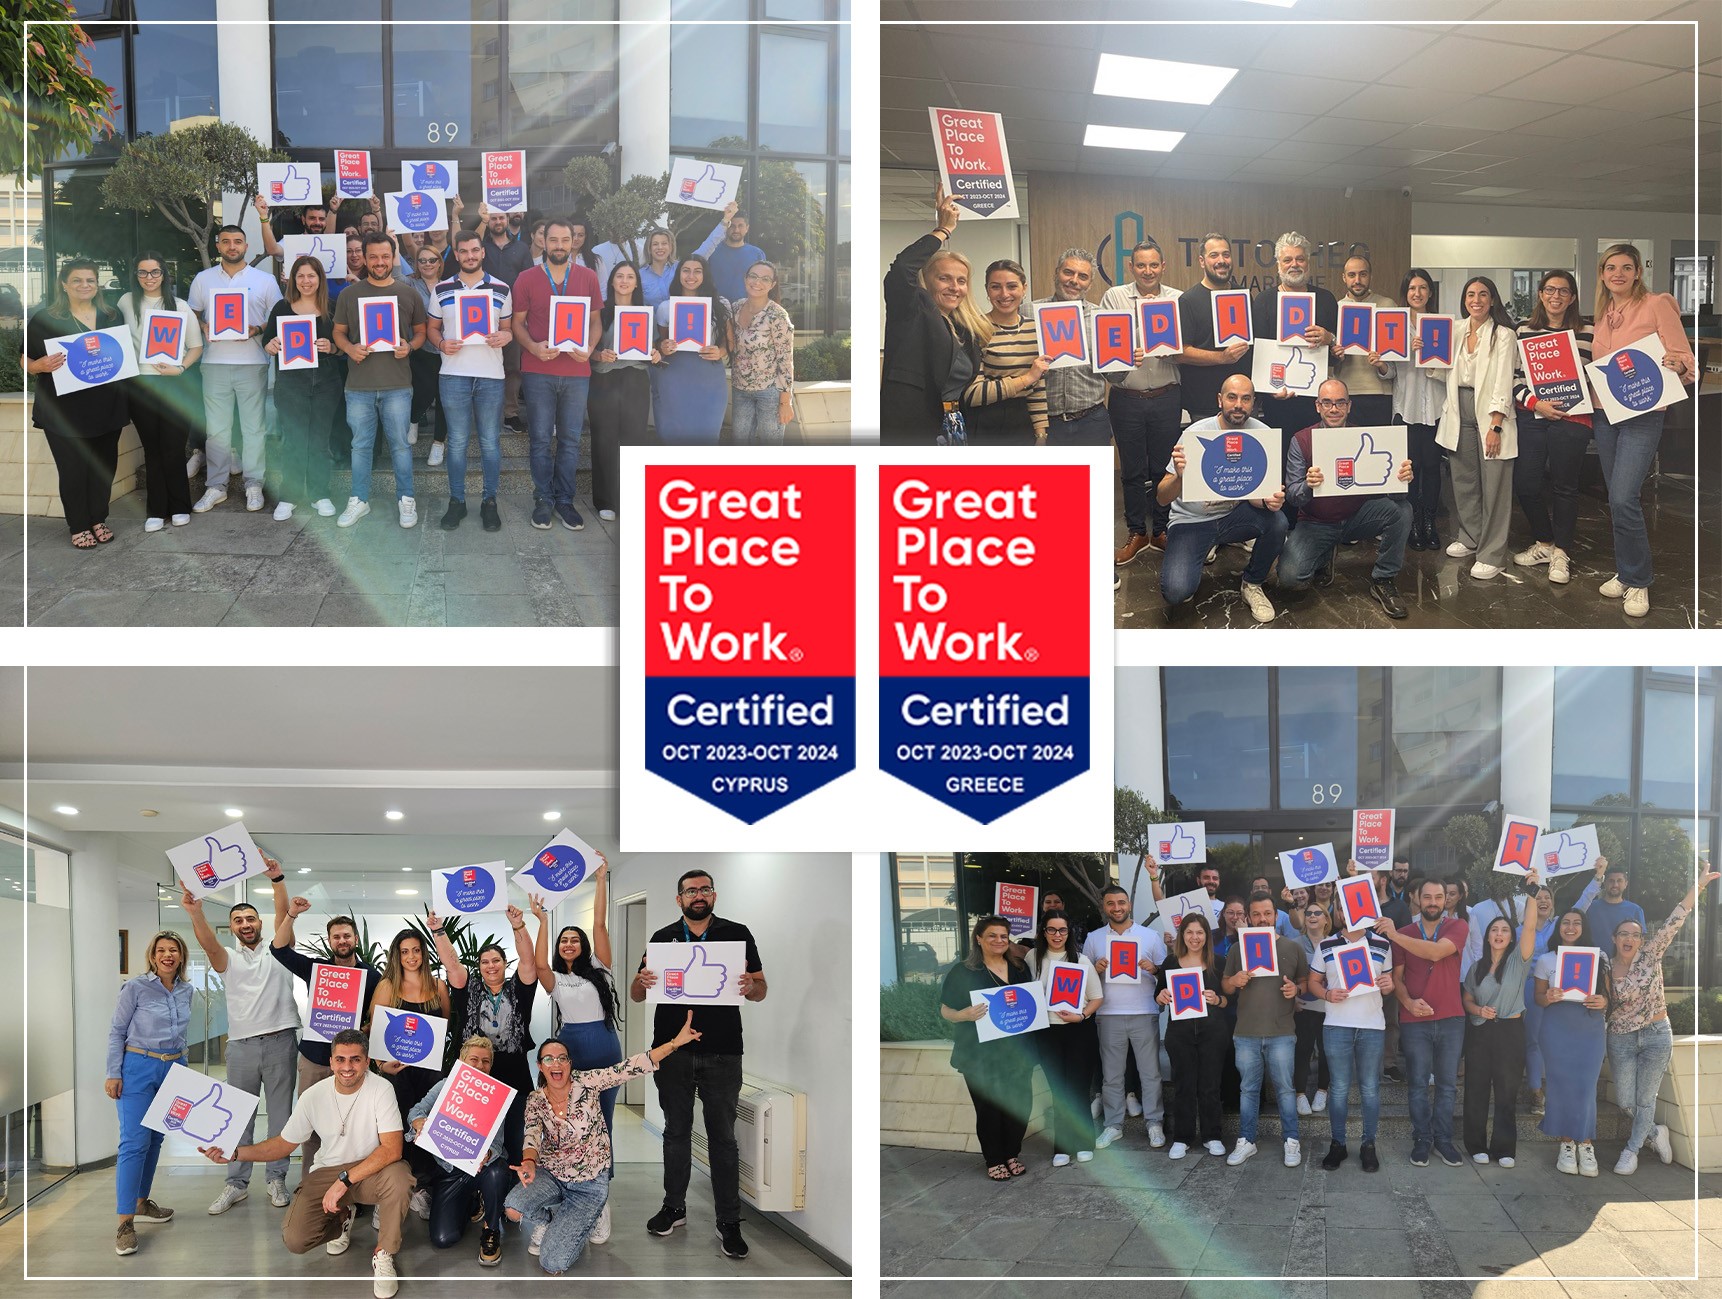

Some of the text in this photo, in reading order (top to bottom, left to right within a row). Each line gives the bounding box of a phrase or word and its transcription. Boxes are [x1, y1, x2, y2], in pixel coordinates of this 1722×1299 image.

[942, 114, 983, 129] Great
[428, 122, 458, 143] 89
[945, 129, 984, 142] Place
[946, 143, 963, 155] To
[489, 162, 512, 170] Place
[956, 179, 1003, 189] Certified
[224, 303, 235, 319] E
[468, 306, 483, 323] D
[1229, 305, 1237, 324] I
[1289, 307, 1305, 325] D
[376, 313, 383, 331] I
[566, 313, 573, 330] I
[687, 313, 694, 330] !
[1151, 313, 1170, 334] D
[1352, 317, 1360, 335] I
[153, 326, 178, 344] W
[627, 322, 641, 339] T
[1046, 319, 1076, 342] W
[1108, 327, 1121, 347] E
[1384, 322, 1398, 340] T
[1432, 328, 1439, 348] !
[290, 331, 306, 349] D
[1526, 338, 1558, 351] Great
[1529, 350, 1560, 361] Place
[1531, 362, 1543, 371] To
[1539, 383, 1577, 395] Certified
[1219, 476, 1236, 485] great
[1236, 475, 1253, 483] place
[1312, 784, 1342, 804] 89
[1515, 833, 1528, 852] T
[1002, 886, 1026, 894] Great
[1002, 892, 1025, 900] Place
[1355, 891, 1364, 909] I
[1119, 950, 1129, 966] E
[1255, 943, 1262, 958] I
[320, 968, 350, 979] Great
[1349, 959, 1363, 977] D
[1573, 962, 1581, 980] !
[318, 987, 329, 996] To
[319, 978, 348, 989] Place
[1056, 977, 1079, 993] W
[1180, 983, 1194, 1001] D
[316, 1012, 351, 1023] Certified
[461, 1069, 496, 1094] Great
[451, 1090, 464, 1104] To
[455, 1081, 490, 1104] Place
[439, 1119, 479, 1146] Certified
